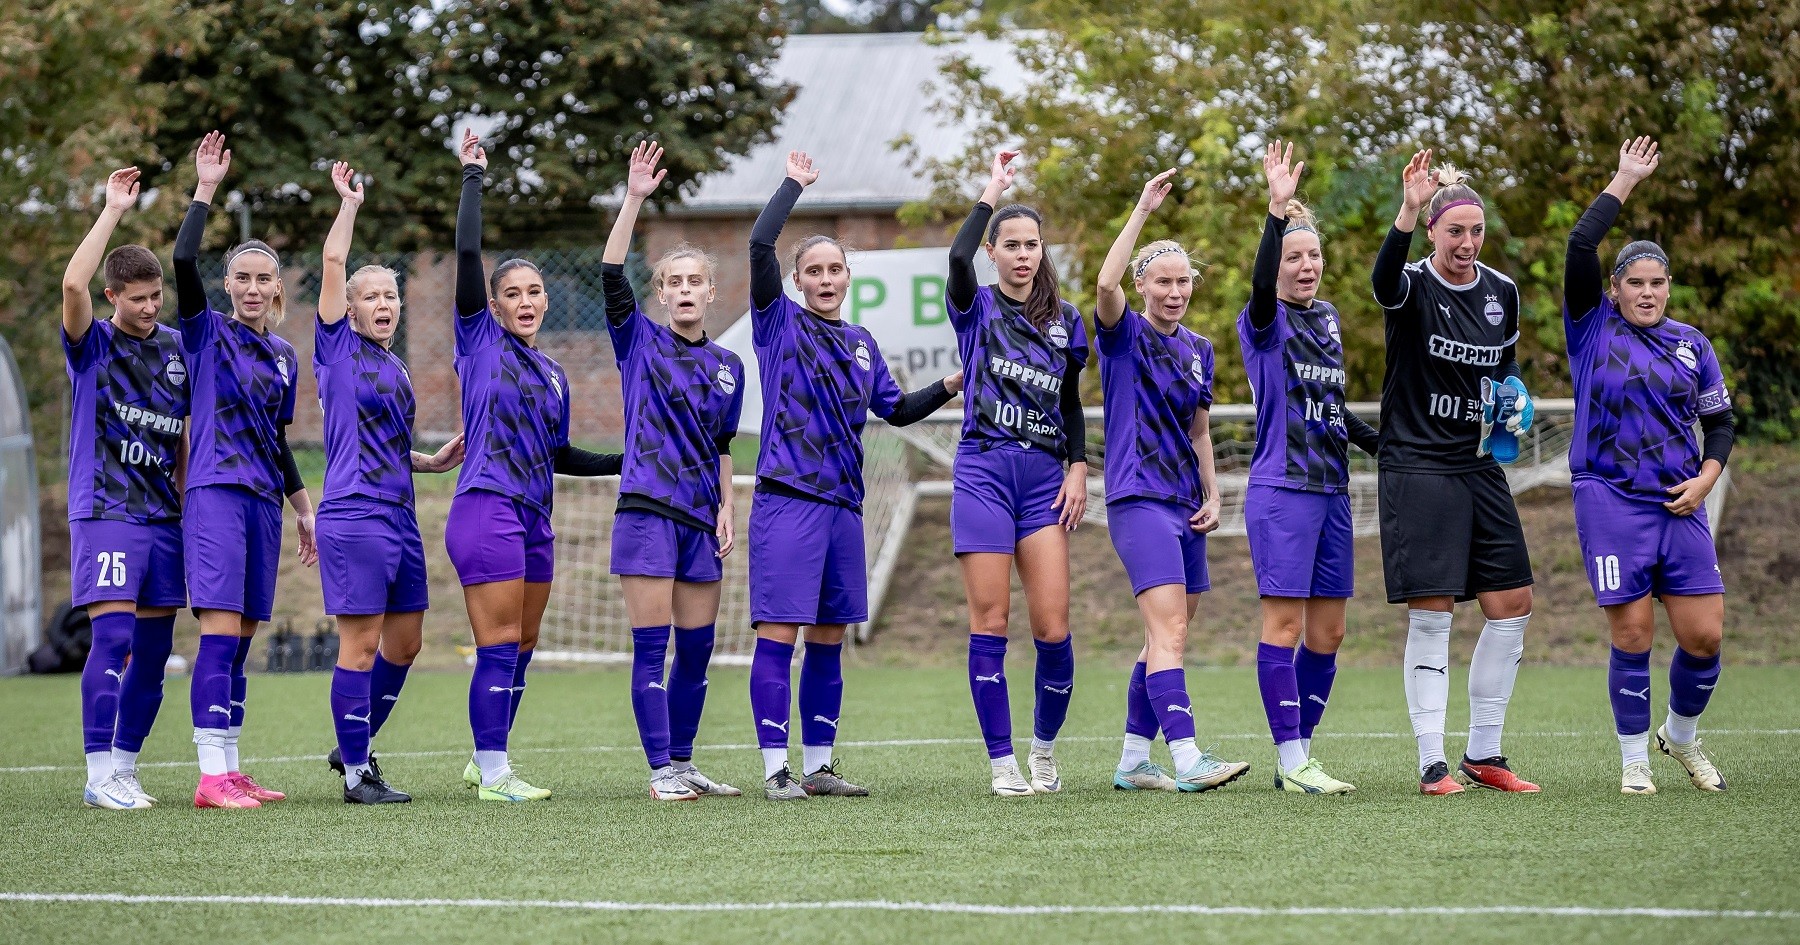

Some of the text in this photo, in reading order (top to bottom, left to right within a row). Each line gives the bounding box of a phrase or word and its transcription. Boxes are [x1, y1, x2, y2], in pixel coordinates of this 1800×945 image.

[994, 400, 1022, 429] 101
[1027, 409, 1046, 421] EV
[1429, 393, 1461, 419] 101
[1329, 416, 1344, 427] PA
[1465, 411, 1484, 422] PA
[1027, 421, 1058, 436] PARK
[96, 551, 127, 588] 25
[1595, 554, 1621, 592] 10
